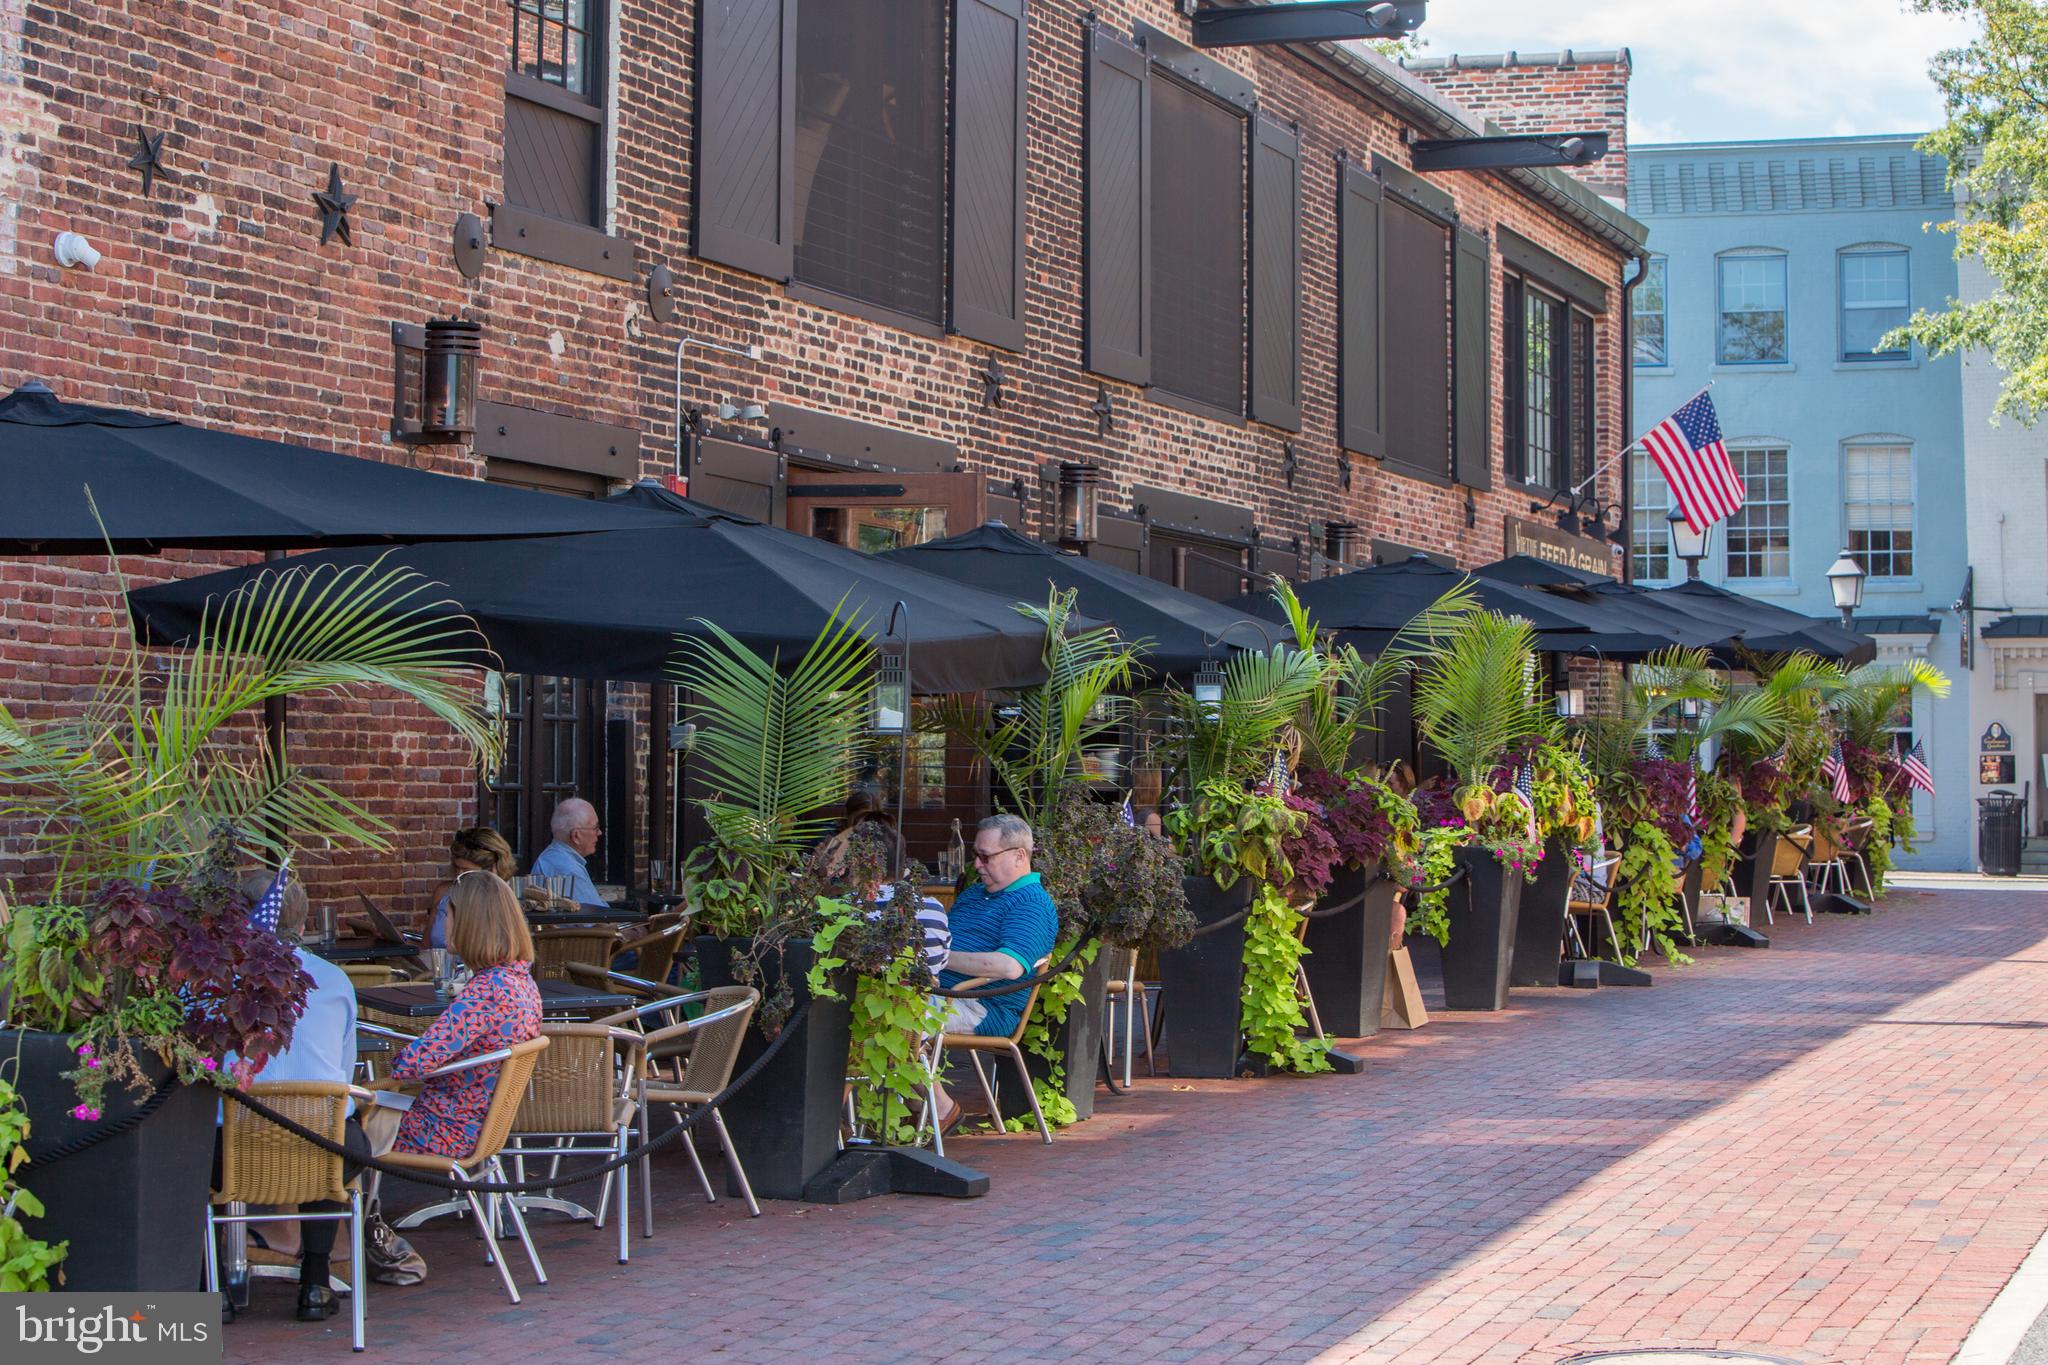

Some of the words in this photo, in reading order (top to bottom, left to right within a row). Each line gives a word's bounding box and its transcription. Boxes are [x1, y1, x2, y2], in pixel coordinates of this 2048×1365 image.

[1540, 541, 1568, 566] FEED
[1568, 546, 1577, 568] &
[1577, 552, 1608, 577] GRAIN
